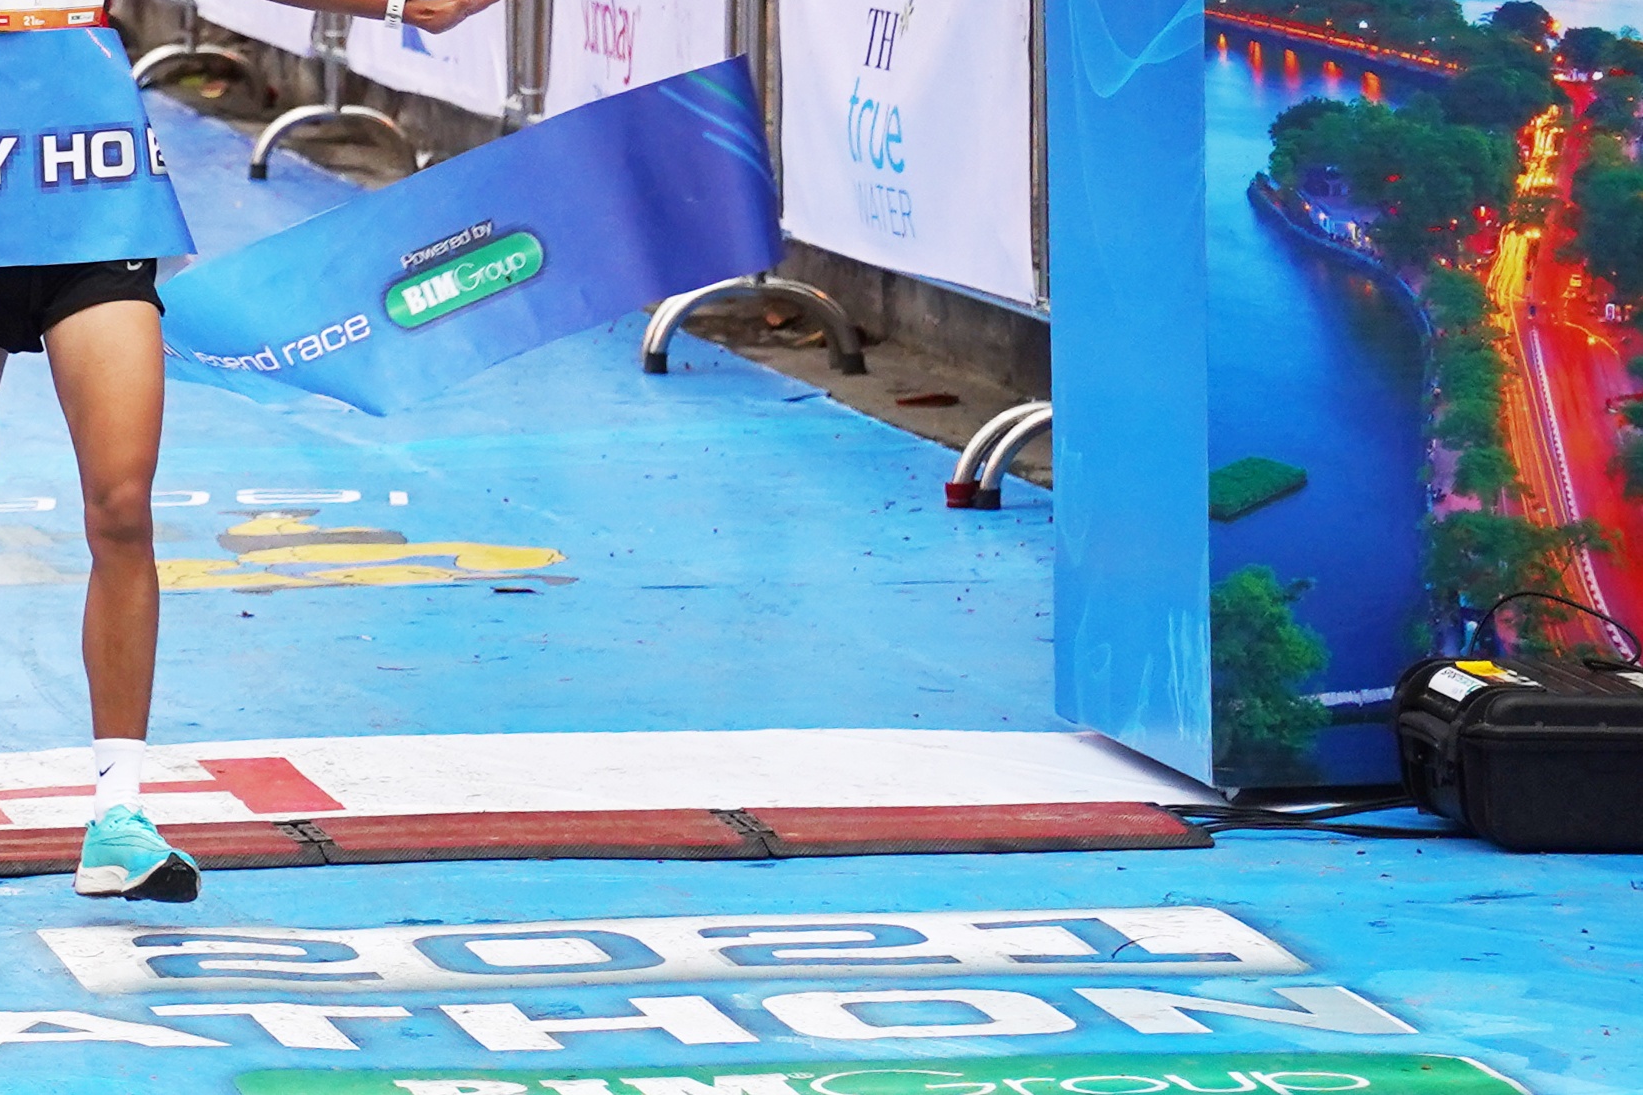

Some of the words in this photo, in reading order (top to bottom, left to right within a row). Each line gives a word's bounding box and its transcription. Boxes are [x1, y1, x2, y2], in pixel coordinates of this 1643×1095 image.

[863, 7, 900, 72] TH
[847, 76, 906, 174] true
[41, 129, 137, 184] HO
[400, 227, 473, 270] Powered
[281, 313, 372, 367] race
[131, 914, 1241, 982] 2021
